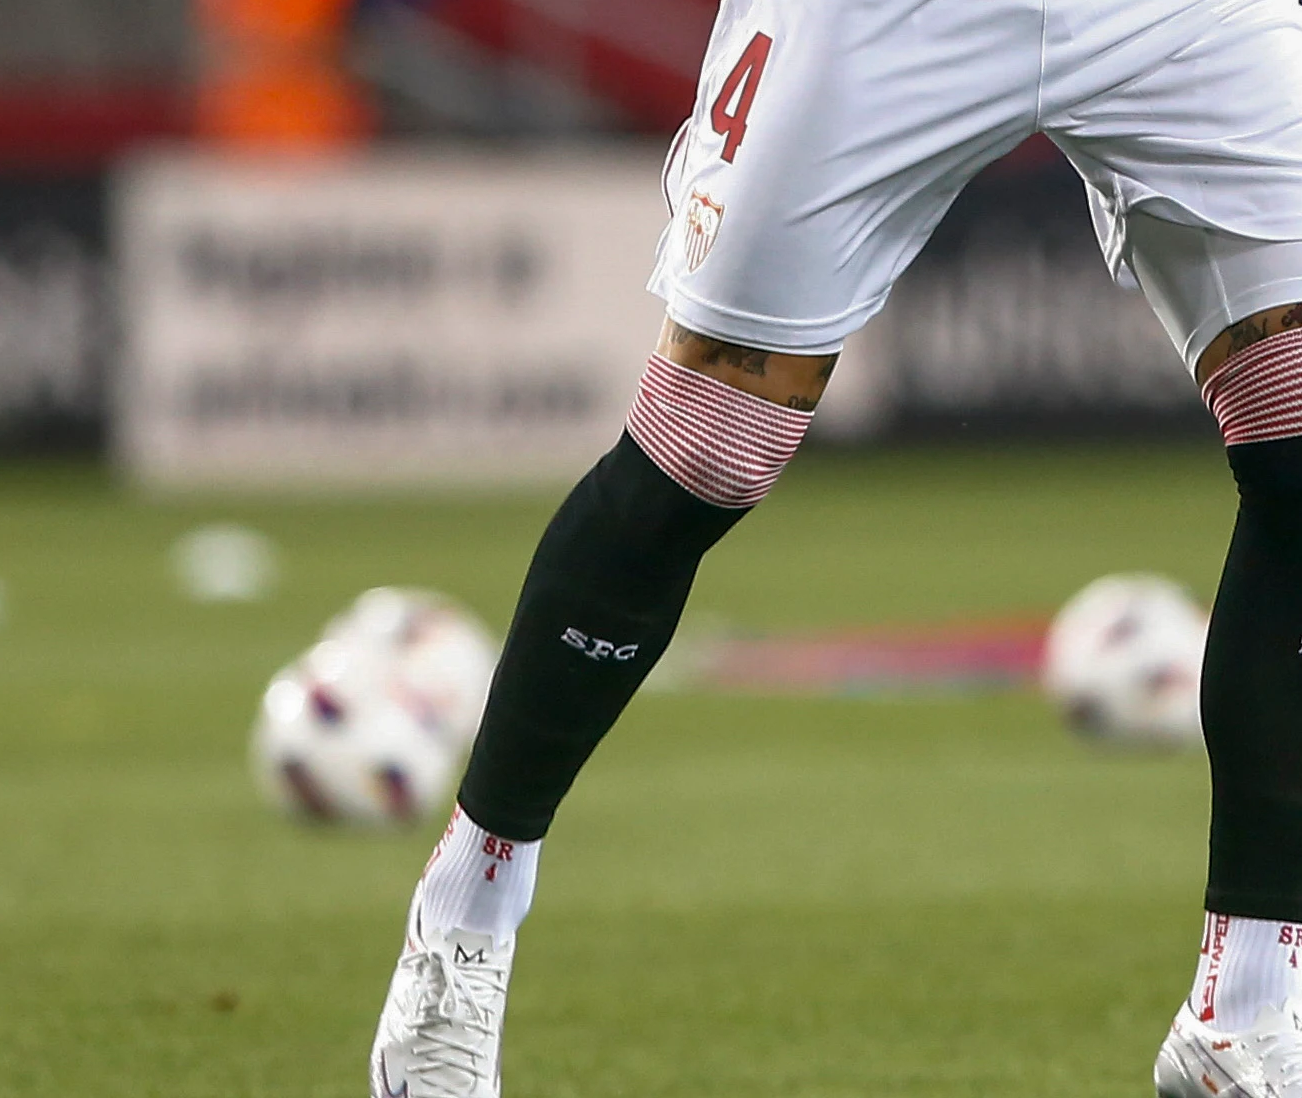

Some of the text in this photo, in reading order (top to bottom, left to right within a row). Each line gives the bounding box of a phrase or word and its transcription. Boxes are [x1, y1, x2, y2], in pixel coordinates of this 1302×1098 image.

[710, 30, 773, 165] 4
[559, 626, 640, 660] SFC
[481, 836, 514, 861] SR
[483, 863, 498, 883] 4
[1289, 948, 1298, 969] 4
